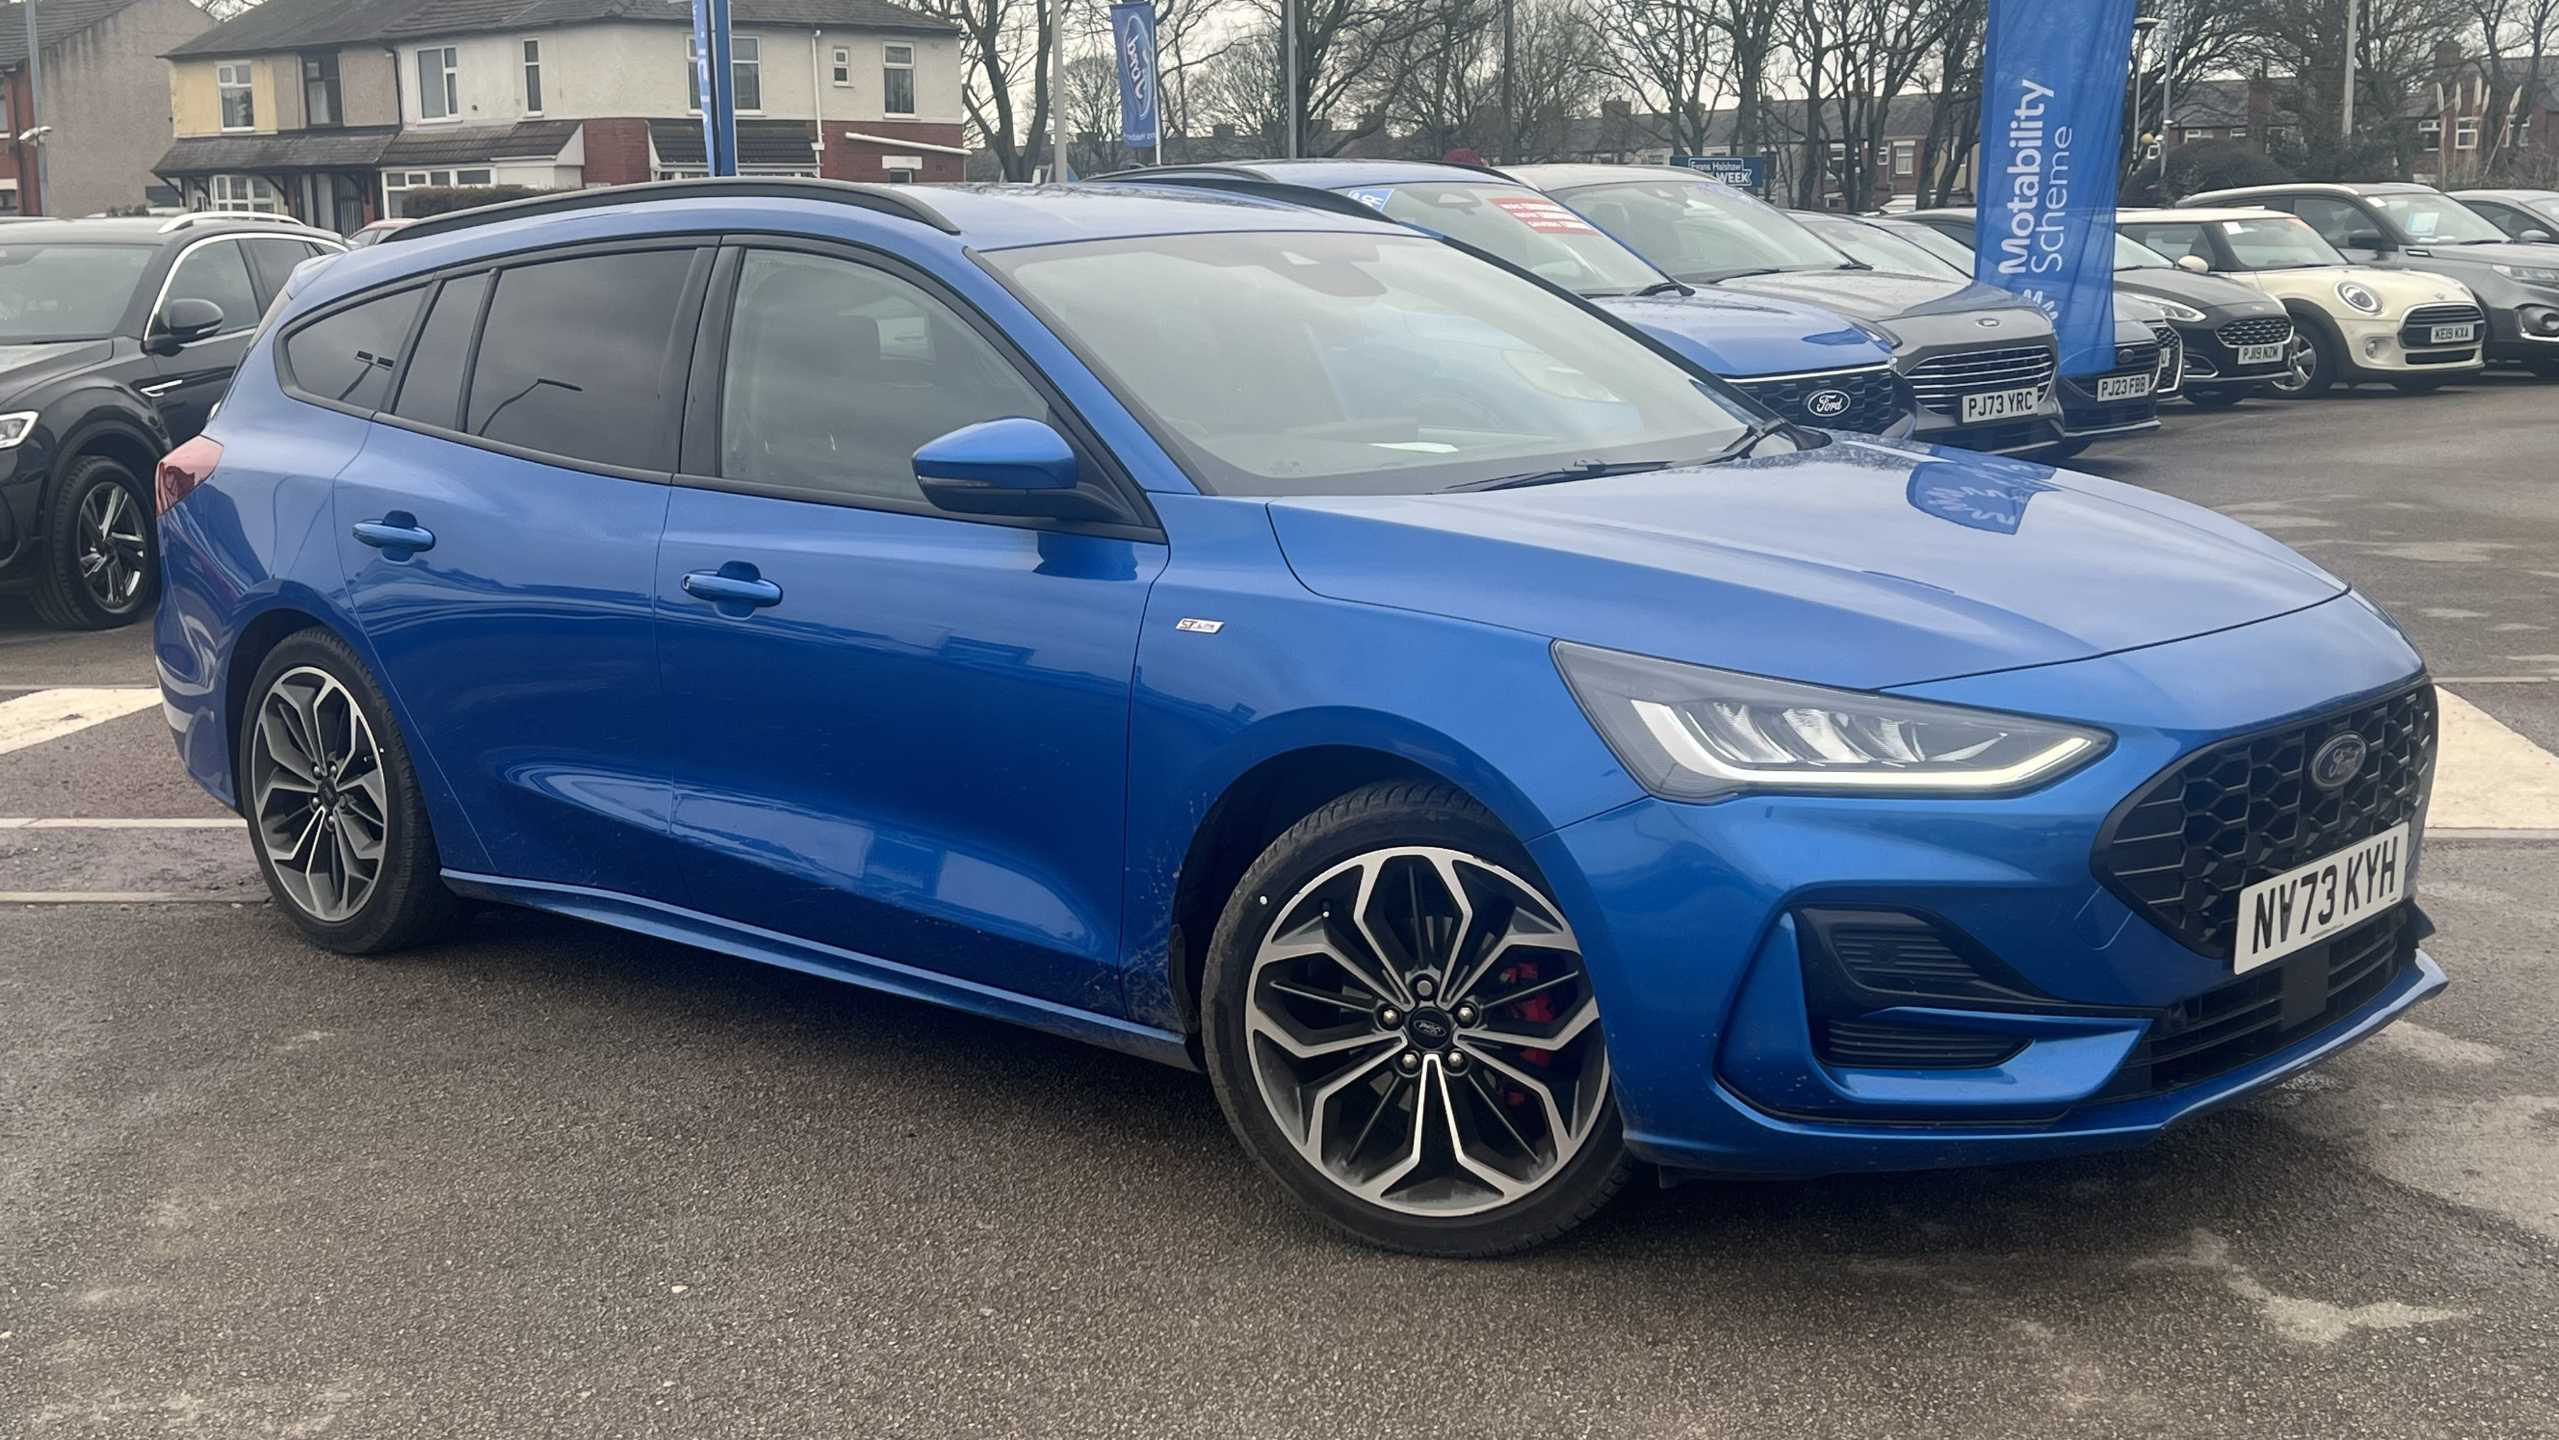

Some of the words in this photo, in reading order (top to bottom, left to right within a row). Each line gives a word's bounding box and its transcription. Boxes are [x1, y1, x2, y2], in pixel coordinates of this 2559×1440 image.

[1716, 172, 1749, 184] WEEK
[1998, 79, 2055, 274] Motability
[2031, 126, 2073, 273] Scheme
[2101, 379, 2127, 398] PJ23
[1816, 394, 1843, 412] Ford
[1968, 394, 2004, 418] PJ73
[2007, 391, 2033, 412] YRC
[2252, 864, 2338, 954] NV73
[2343, 836, 2398, 915] KYH
